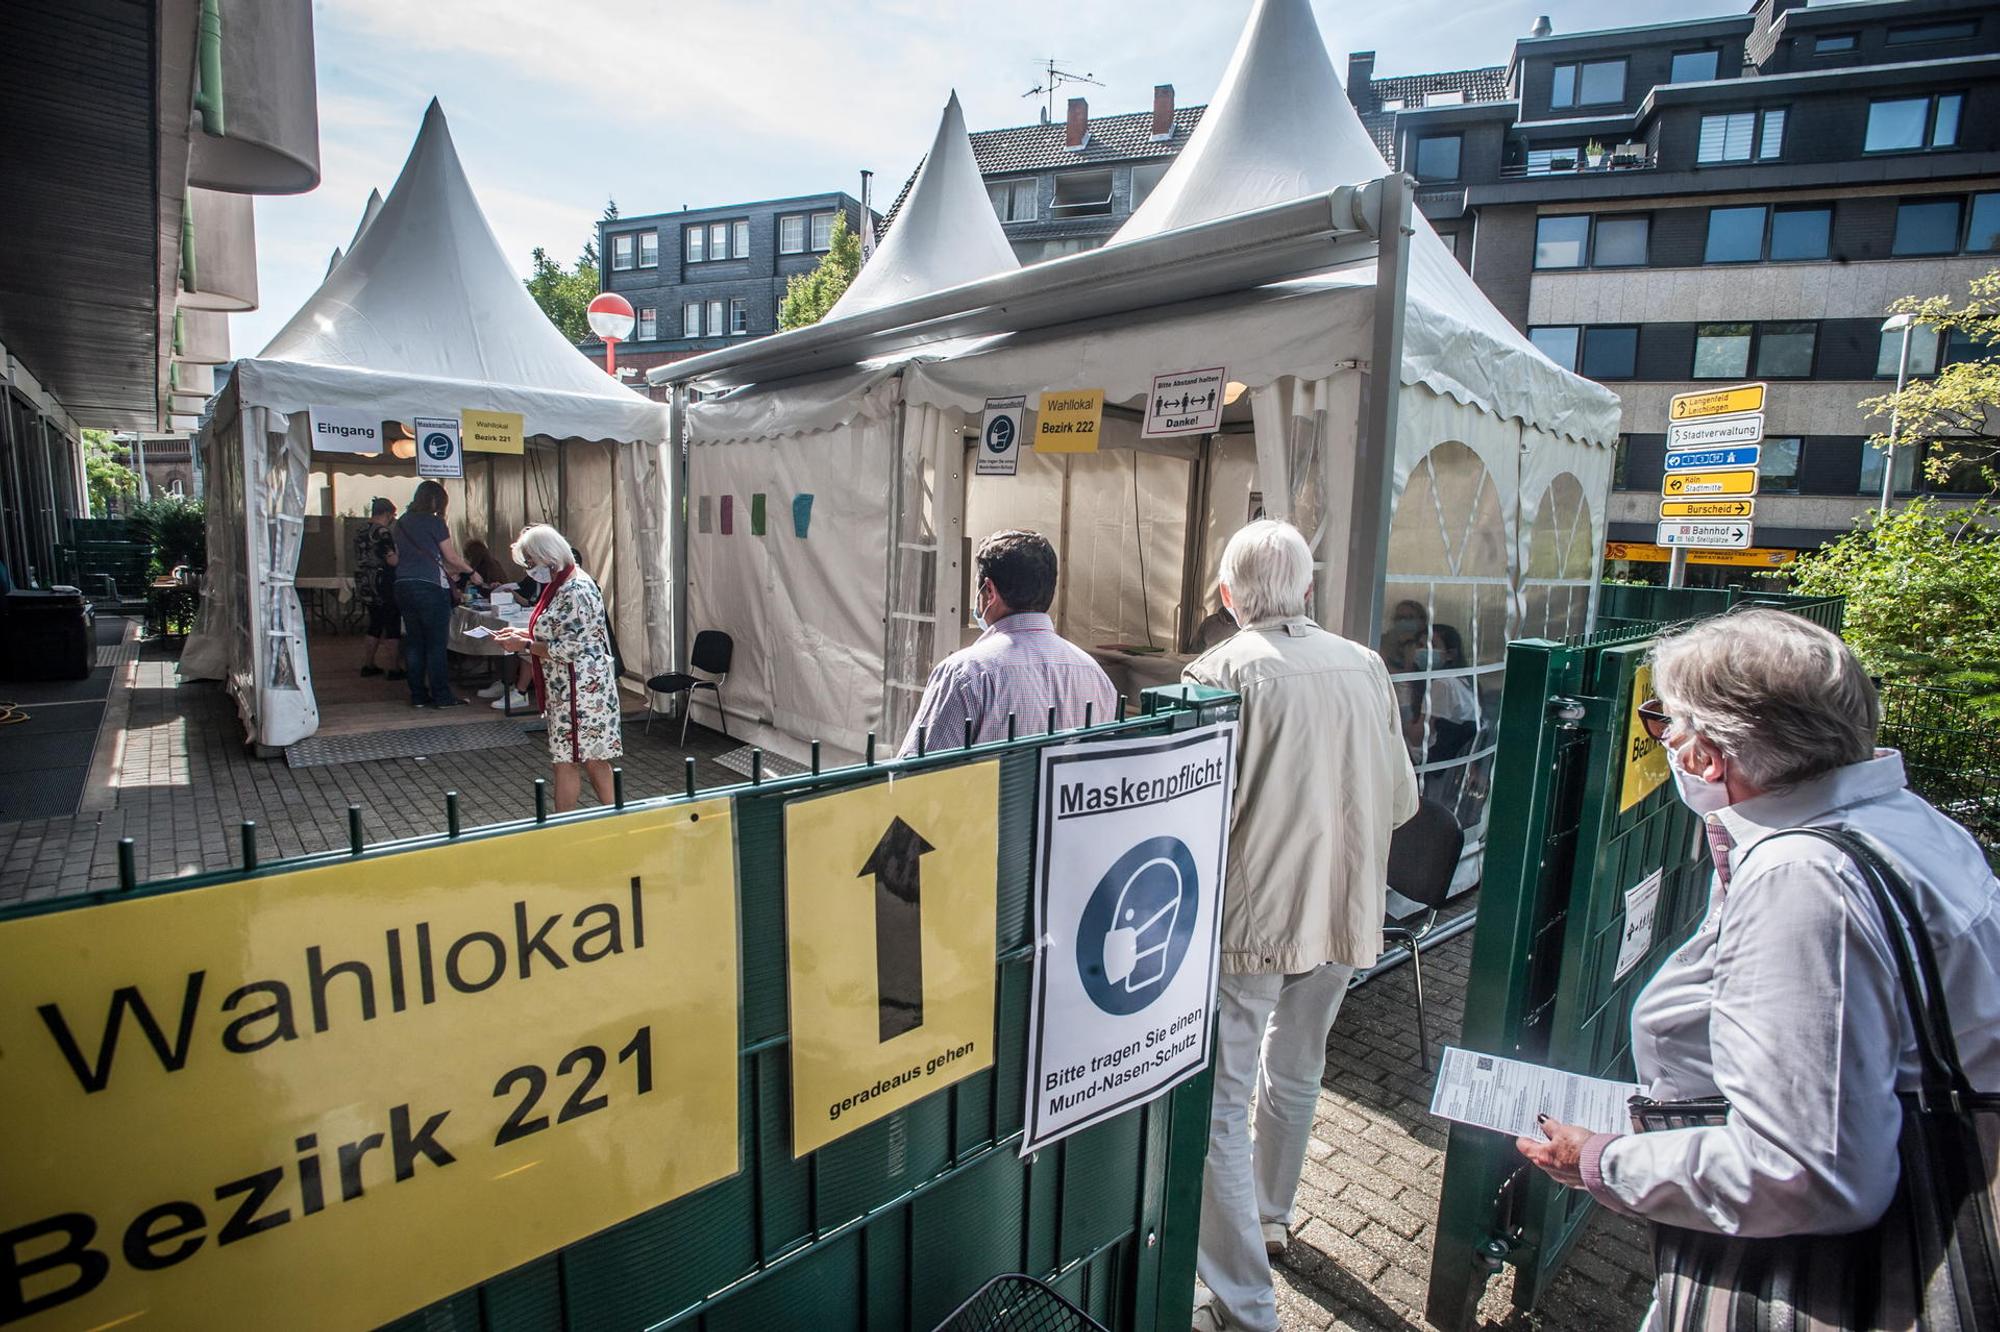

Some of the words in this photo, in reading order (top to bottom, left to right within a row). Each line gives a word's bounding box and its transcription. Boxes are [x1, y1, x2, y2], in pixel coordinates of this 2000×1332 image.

[1173, 378, 1198, 387] Abstand
[1047, 398, 1094, 411] Wahllokal
[1689, 393, 1729, 406] Langenfeld
[1689, 404, 1729, 415] Leichlingen
[476, 421, 509, 429] Wahllokal
[1042, 422, 1073, 434] Bezirk
[1075, 421, 1094, 433] 222
[1166, 416, 1198, 428] Danke!
[317, 422, 375, 438] Eingang
[1682, 426, 1756, 440] Stadtverwaltung
[475, 434, 497, 442] Bezirk
[1685, 484, 1722, 492] Stadtmitte
[1687, 504, 1732, 513] Burscheid
[1693, 526, 1730, 535] Bahnhof
[1059, 757, 1222, 814] Maskenpflicht
[37, 876, 646, 1095] Wahllokal
[1045, 1064, 1086, 1093] Bitte
[1090, 1040, 1141, 1074] tragen
[1145, 1027, 1166, 1052] Sie
[1169, 1007, 1202, 1037] einen
[829, 1067, 921, 1120] geradeaus
[926, 1041, 975, 1076] gehen
[1049, 1032, 1197, 1116] Mund-Nasen-Schutz
[0, 1104, 457, 1325] Bezirk
[493, 1026, 654, 1147] 221
